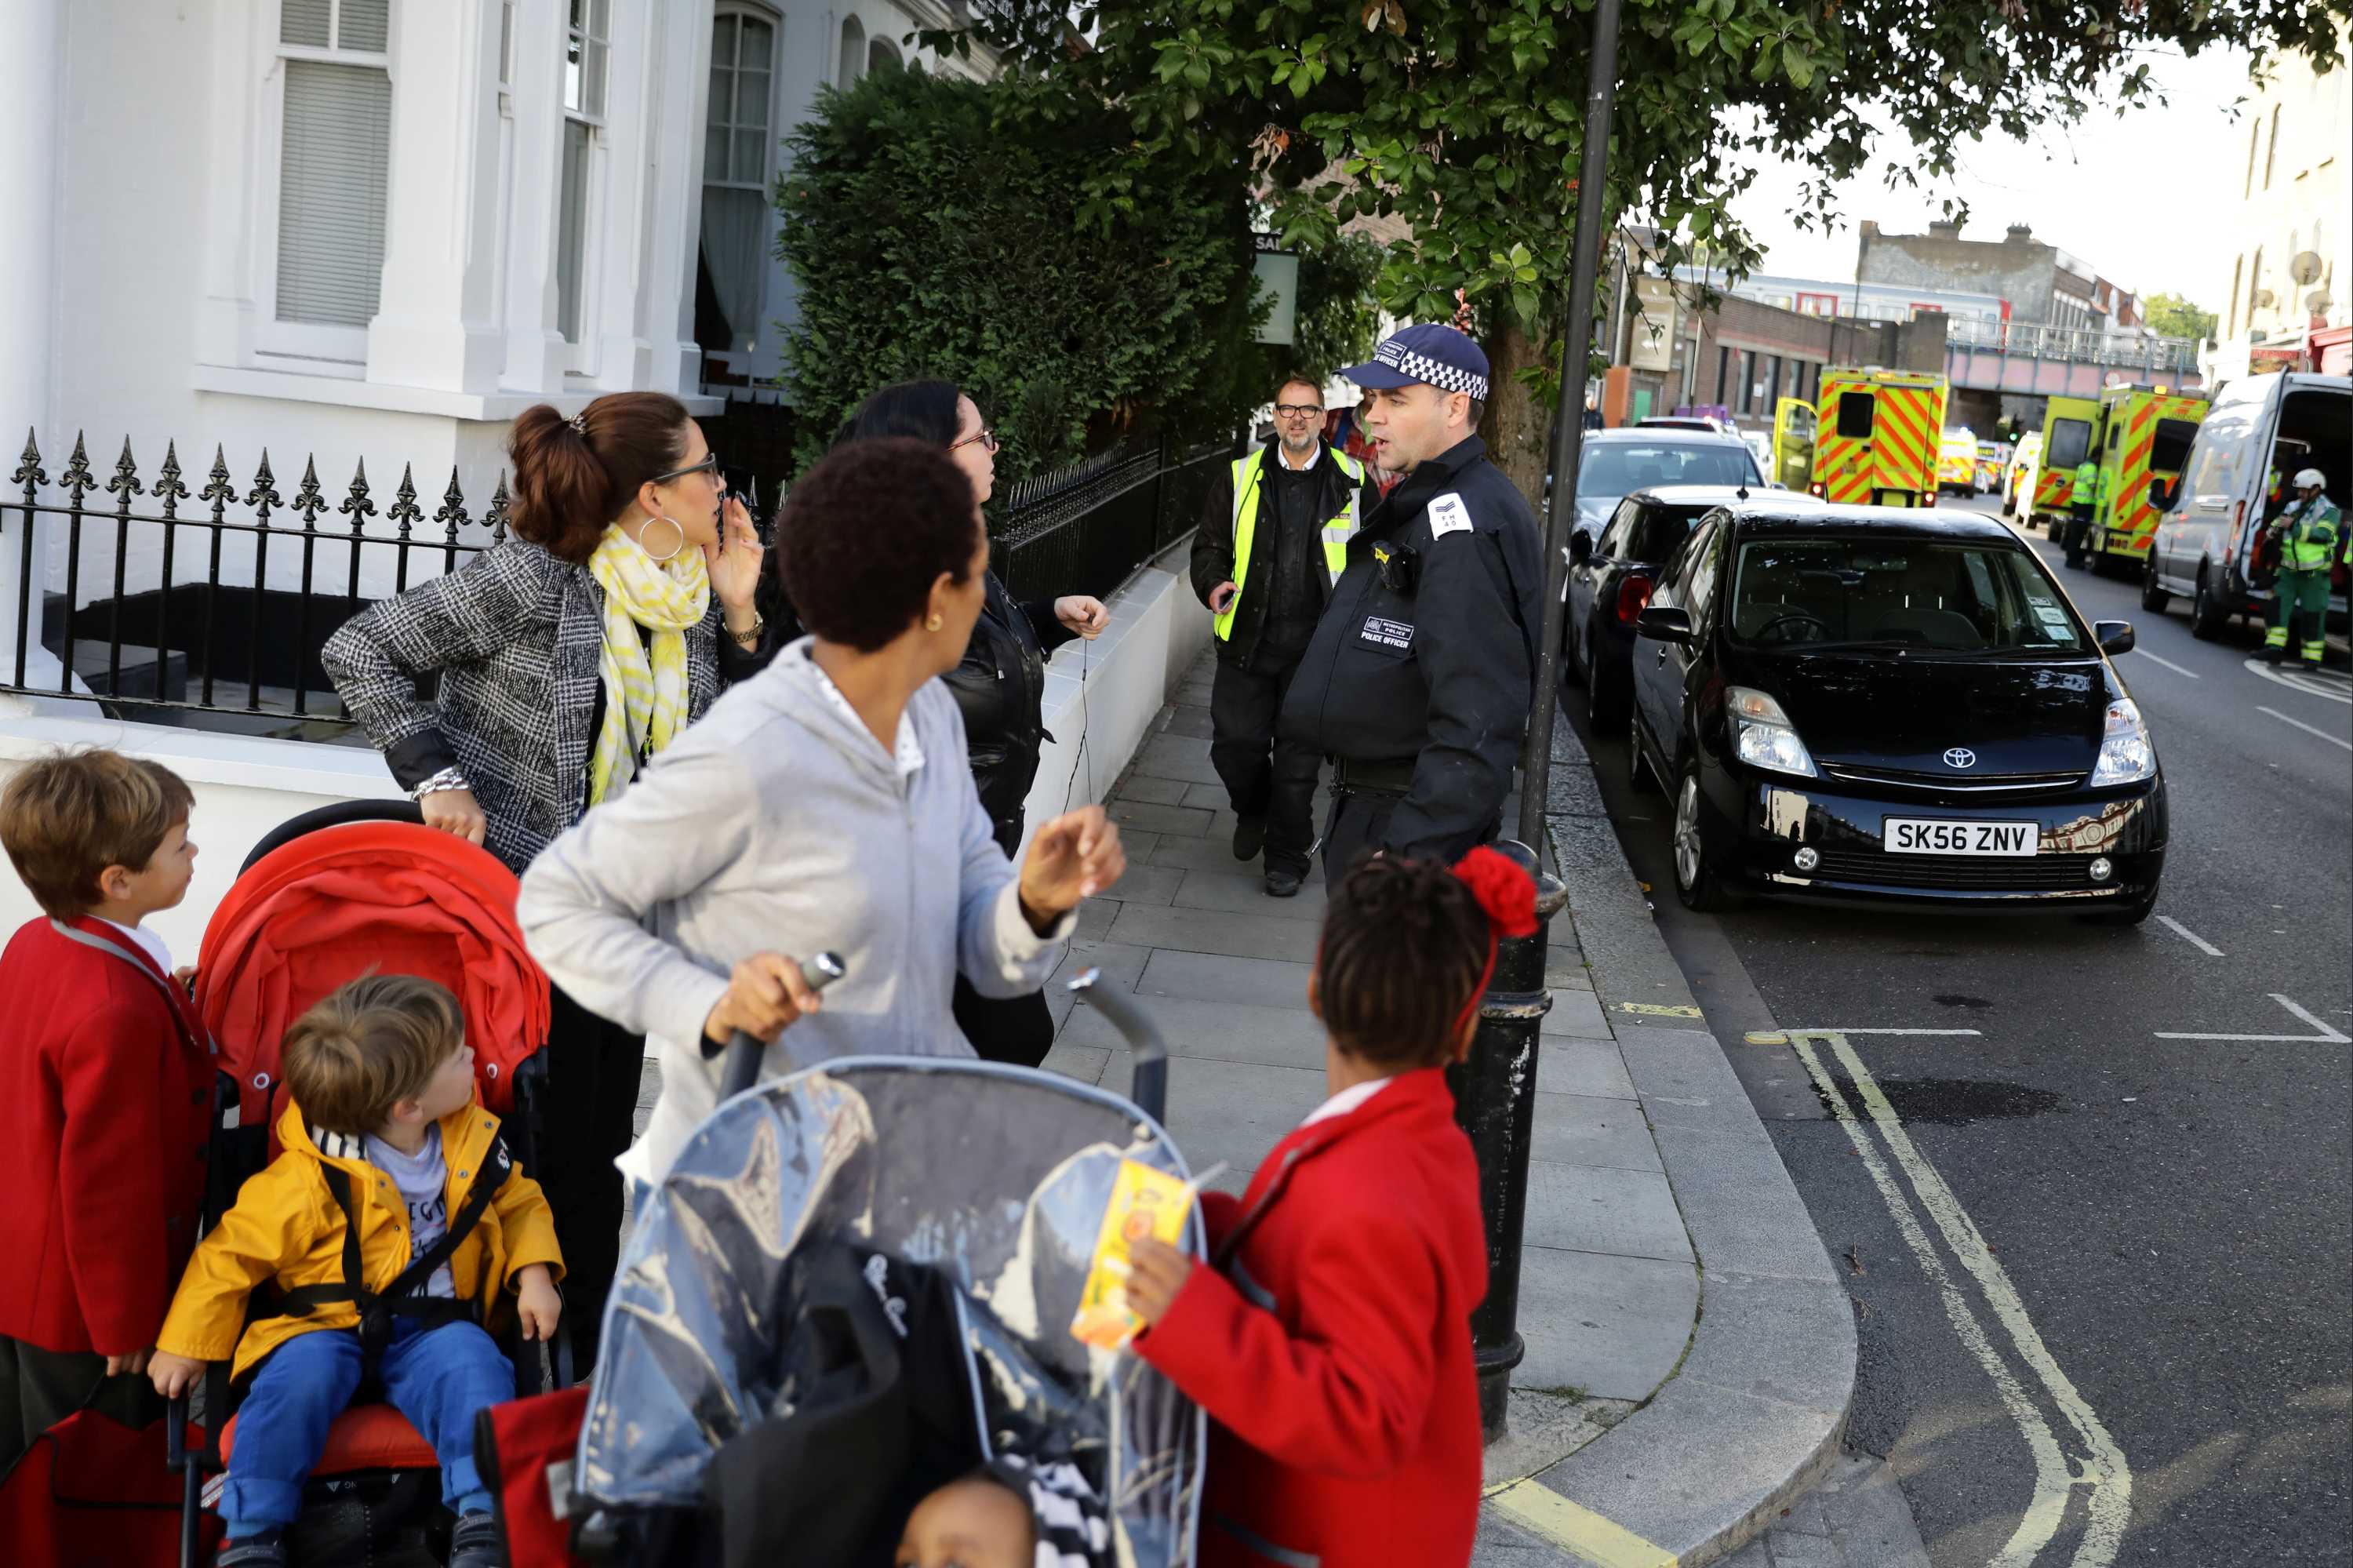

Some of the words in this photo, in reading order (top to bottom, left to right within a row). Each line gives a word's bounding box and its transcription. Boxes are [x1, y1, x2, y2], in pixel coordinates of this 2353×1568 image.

[1383, 622, 1411, 632] METROPOLITAN
[1384, 628, 1406, 636] POLICE
[1361, 631, 1383, 642] POLICE
[1383, 636, 1409, 649] OFFICER
[1897, 824, 1967, 850] SK56
[1975, 827, 2027, 851] ZNV
